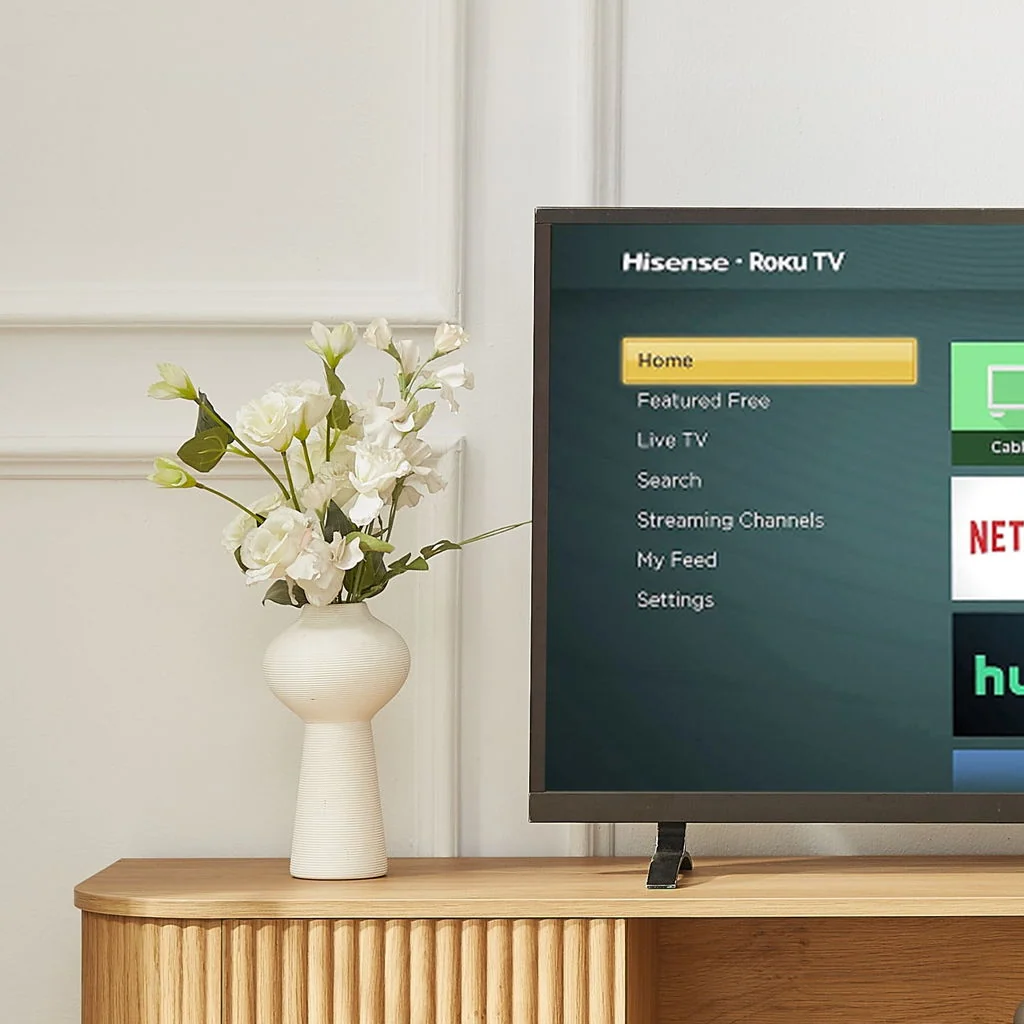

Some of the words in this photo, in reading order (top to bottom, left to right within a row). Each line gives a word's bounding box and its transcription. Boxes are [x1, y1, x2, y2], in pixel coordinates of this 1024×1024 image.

[621, 251, 730, 273] Hisense
[748, 251, 808, 273] Roku
[812, 251, 847, 272] TV
[637, 352, 694, 369] Home
[637, 392, 722, 410] Featured
[727, 392, 772, 410] Free
[637, 431, 677, 449] Live
[681, 431, 709, 448] TV
[637, 471, 703, 489] Search
[637, 510, 734, 531] Streaming
[738, 510, 826, 530] Channels
[636, 551, 665, 571] My
[670, 551, 718, 569] Feed
[636, 591, 716, 612] Settings
